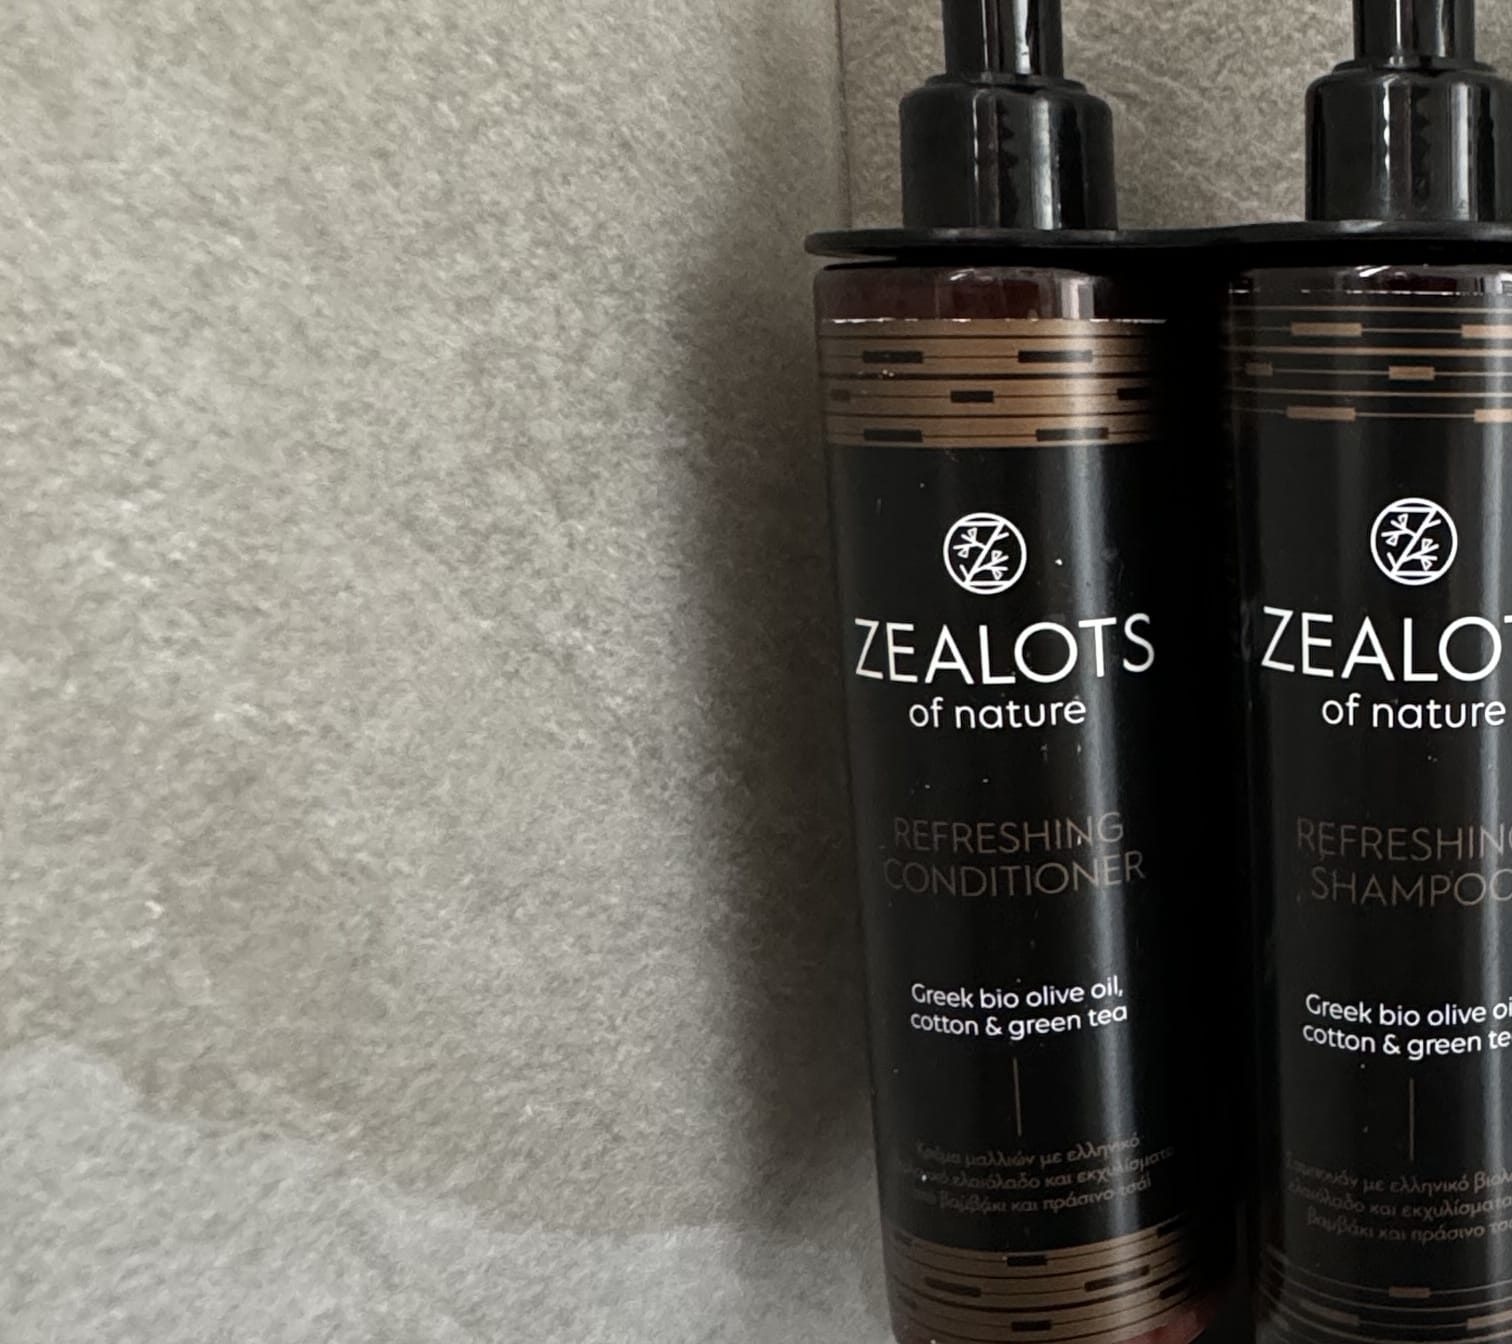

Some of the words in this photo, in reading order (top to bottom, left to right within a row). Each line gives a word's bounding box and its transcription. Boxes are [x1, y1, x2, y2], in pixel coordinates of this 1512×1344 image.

[855, 613, 1154, 685] ZEALOTS
[909, 697, 944, 728] of
[955, 699, 1087, 729] nature
[1322, 693, 1361, 726] of
[1372, 698, 1506, 729] nature
[894, 812, 1124, 854] REFRESHING
[884, 850, 1146, 897] CONDITIONER
[911, 983, 974, 1008] Greek
[980, 988, 1019, 1009] bio
[1026, 985, 1085, 1007] olive
[1091, 975, 1123, 998] oil,
[910, 1013, 979, 1036] cotton
[985, 1016, 1003, 1036] &
[1008, 1015, 1081, 1041] green
[1088, 1005, 1127, 1027] tea
[1305, 993, 1372, 1024] Greek
[1379, 1004, 1420, 1027] bio
[1427, 1003, 1486, 1026] olive
[1302, 1025, 1375, 1053] cotton
[1383, 1034, 1400, 1055] &
[1407, 1033, 1481, 1061] green
[1039, 1152, 1063, 1169] με
[1045, 1174, 1072, 1187] και
[1363, 1178, 1384, 1193] με
[1390, 1174, 1470, 1197] ελληνικό
[1011, 1200, 1038, 1212] και
[1043, 1192, 1114, 1213] πράσινο
[1370, 1204, 1396, 1216] και
[1378, 1228, 1406, 1241] και
[1411, 1225, 1485, 1246] πράσινο
